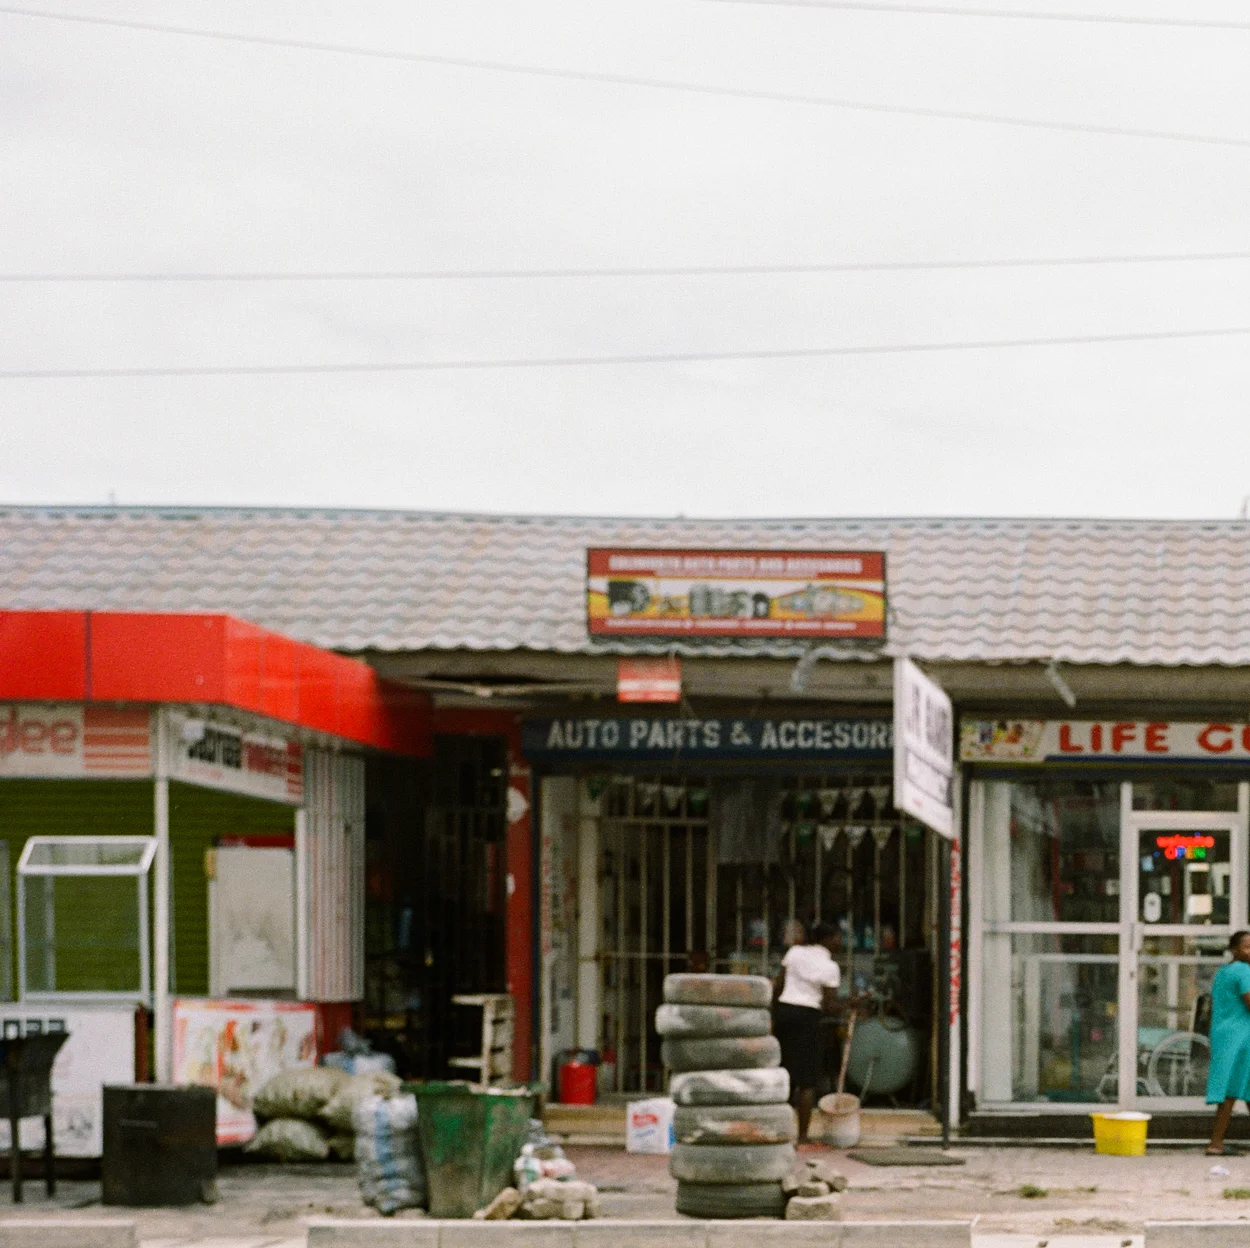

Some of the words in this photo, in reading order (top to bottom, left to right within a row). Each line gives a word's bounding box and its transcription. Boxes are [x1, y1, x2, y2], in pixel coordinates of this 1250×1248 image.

[547, 720, 620, 749] AUTO
[629, 720, 720, 749] PARTS
[731, 721, 752, 747] &
[1058, 722, 1170, 752] LIFE
